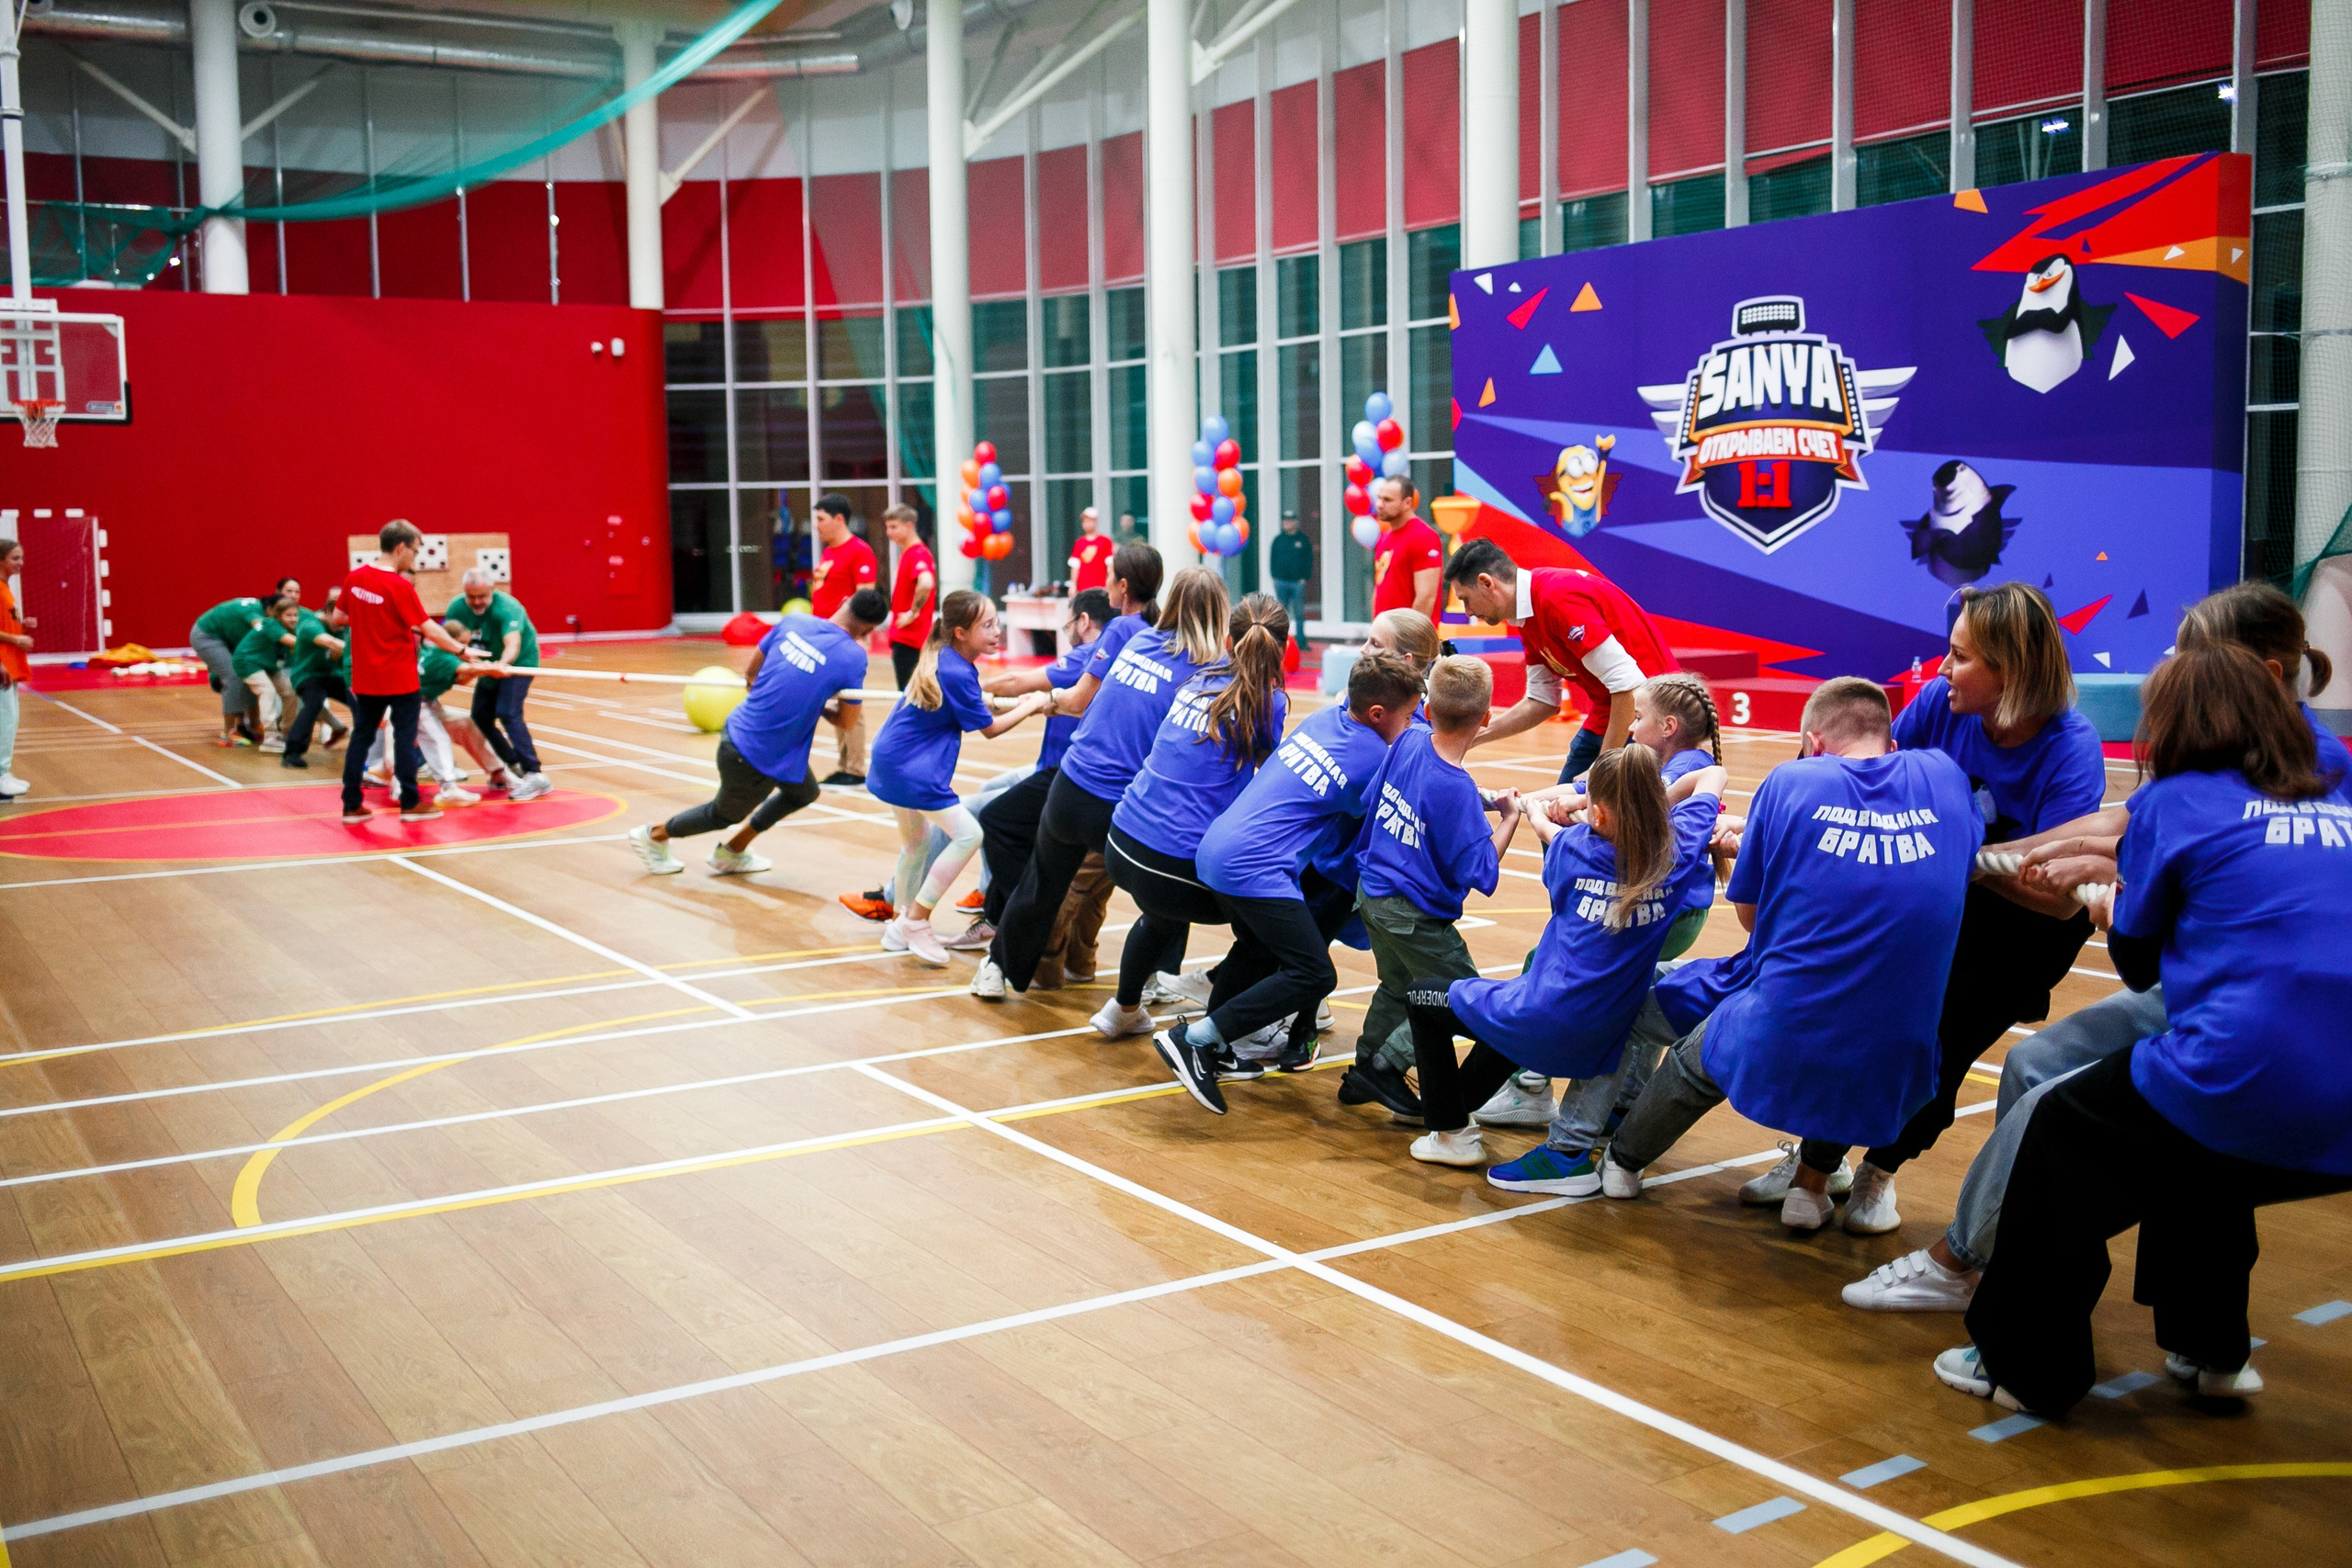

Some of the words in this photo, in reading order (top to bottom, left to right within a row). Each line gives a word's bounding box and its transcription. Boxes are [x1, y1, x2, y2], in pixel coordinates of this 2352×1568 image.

[1698, 343, 1843, 420] SANYA
[1699, 428, 1796, 464] ОТКРЫВАЕМ
[1797, 427, 1838, 459] СЧЕТ
[1737, 460, 1792, 508] 1:1
[1731, 692, 1750, 725] 3
[1812, 805, 1939, 830] ПОДВОДНАЯ
[1817, 827, 1936, 864] БРАТВА
[1407, 989, 1452, 1009] ONDERFUL
